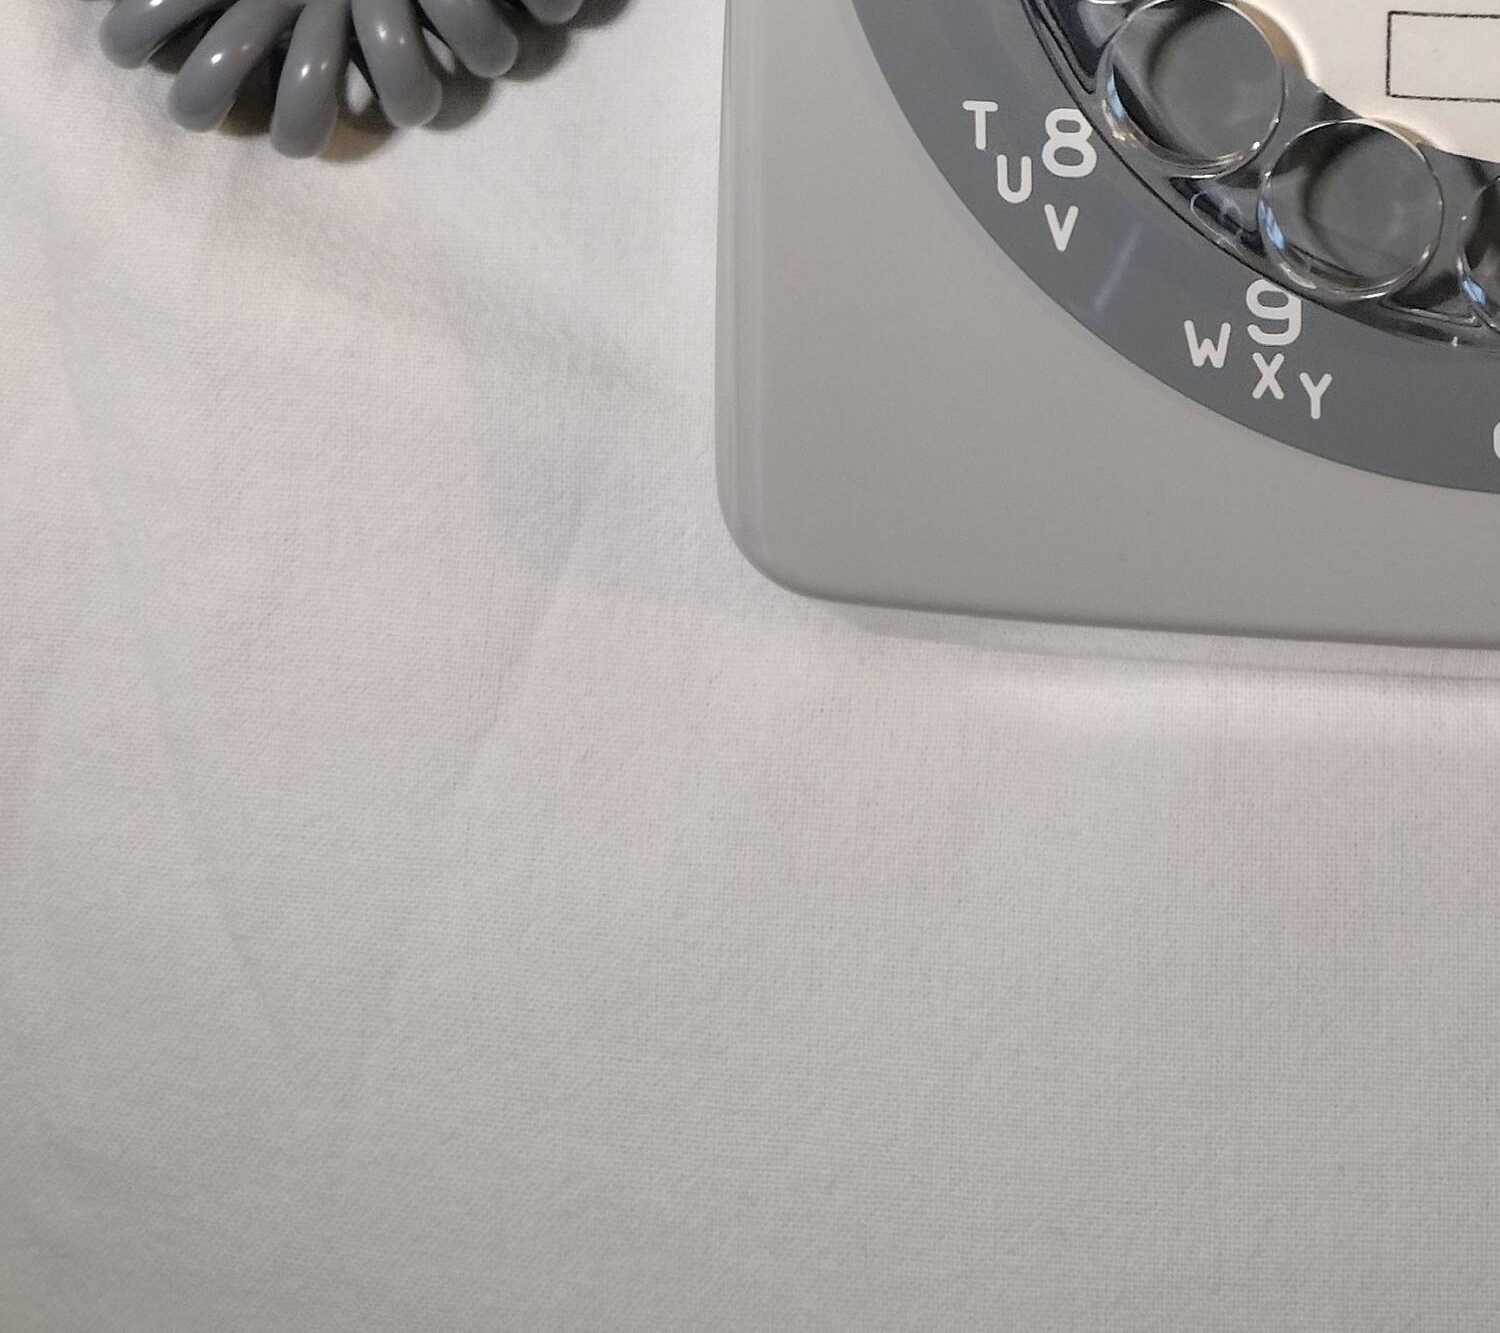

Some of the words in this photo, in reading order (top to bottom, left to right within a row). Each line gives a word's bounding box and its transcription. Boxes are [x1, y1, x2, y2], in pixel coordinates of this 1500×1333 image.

[1041, 108, 1098, 178] 8
[1245, 278, 1302, 347] 9
[1183, 319, 1332, 420] WXY
